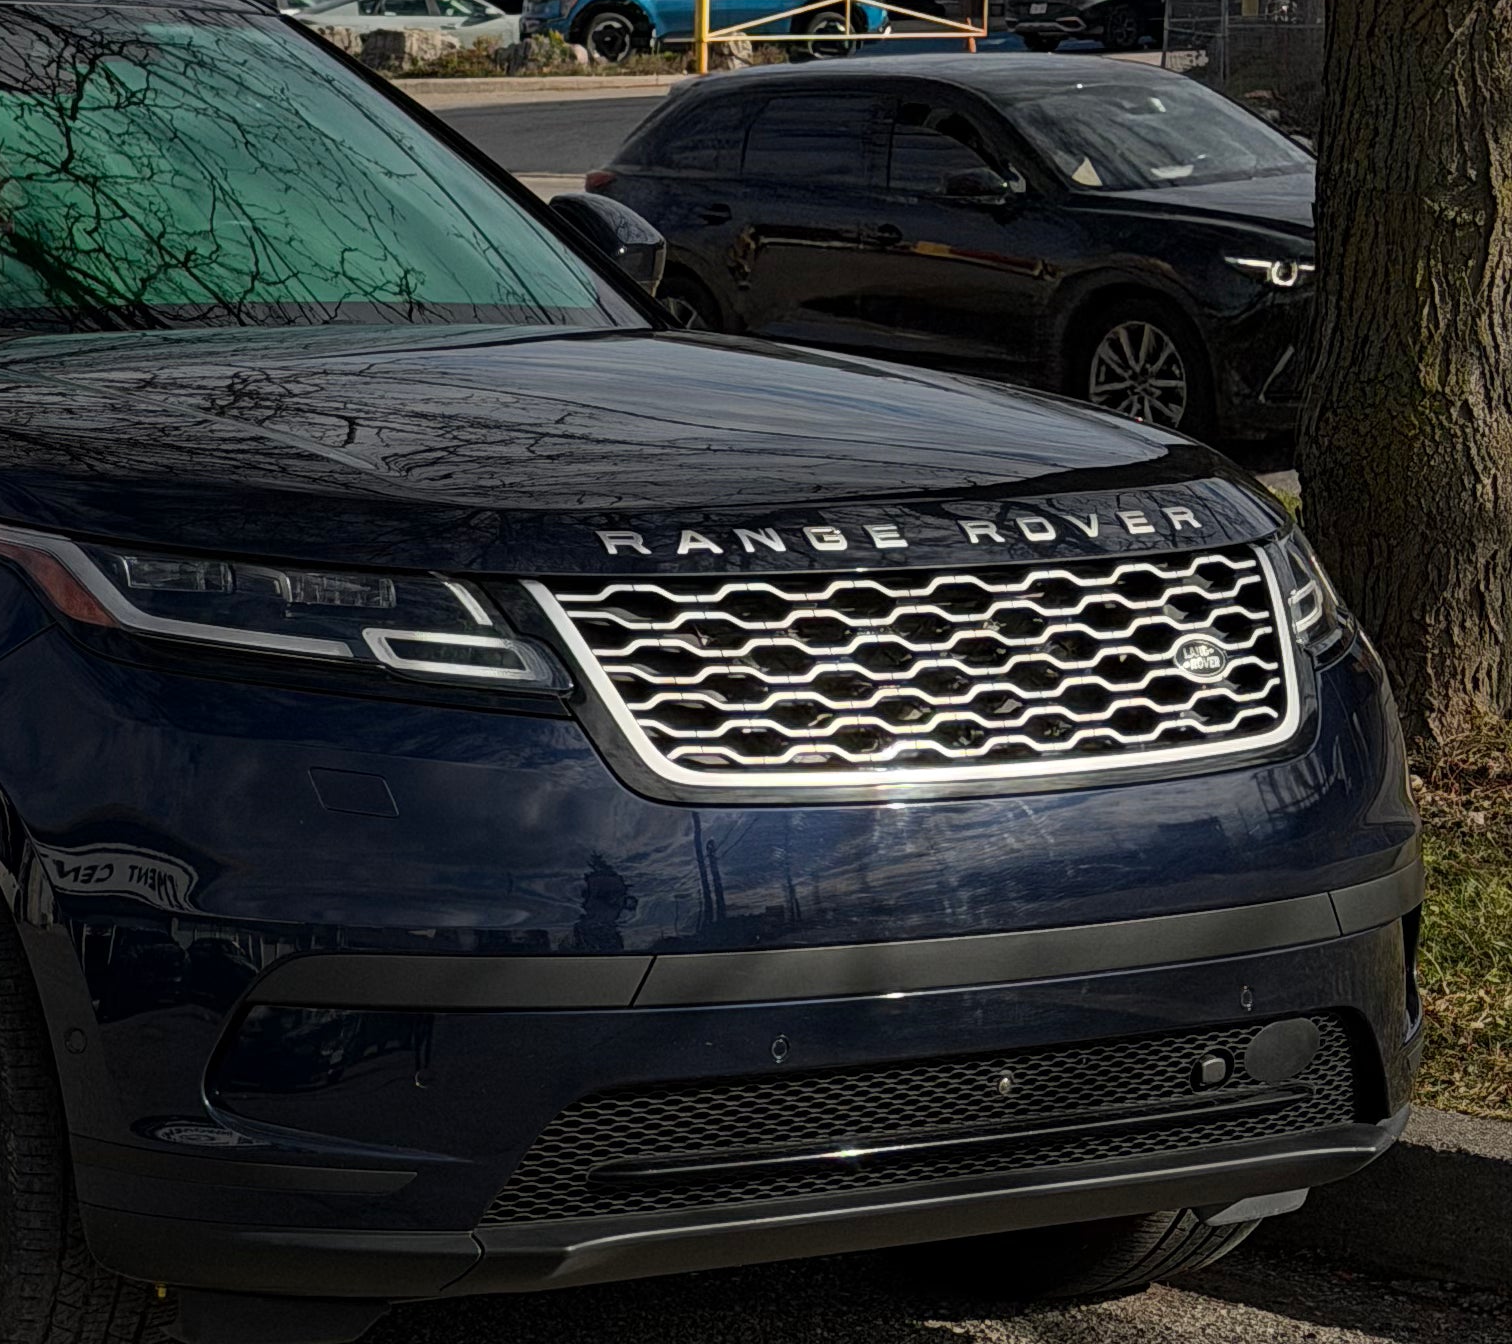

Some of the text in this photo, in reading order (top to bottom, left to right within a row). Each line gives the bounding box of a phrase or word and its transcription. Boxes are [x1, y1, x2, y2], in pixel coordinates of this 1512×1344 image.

[598, 506, 1202, 556] RANGE ROVER
[1191, 656, 1220, 669] ROVER
